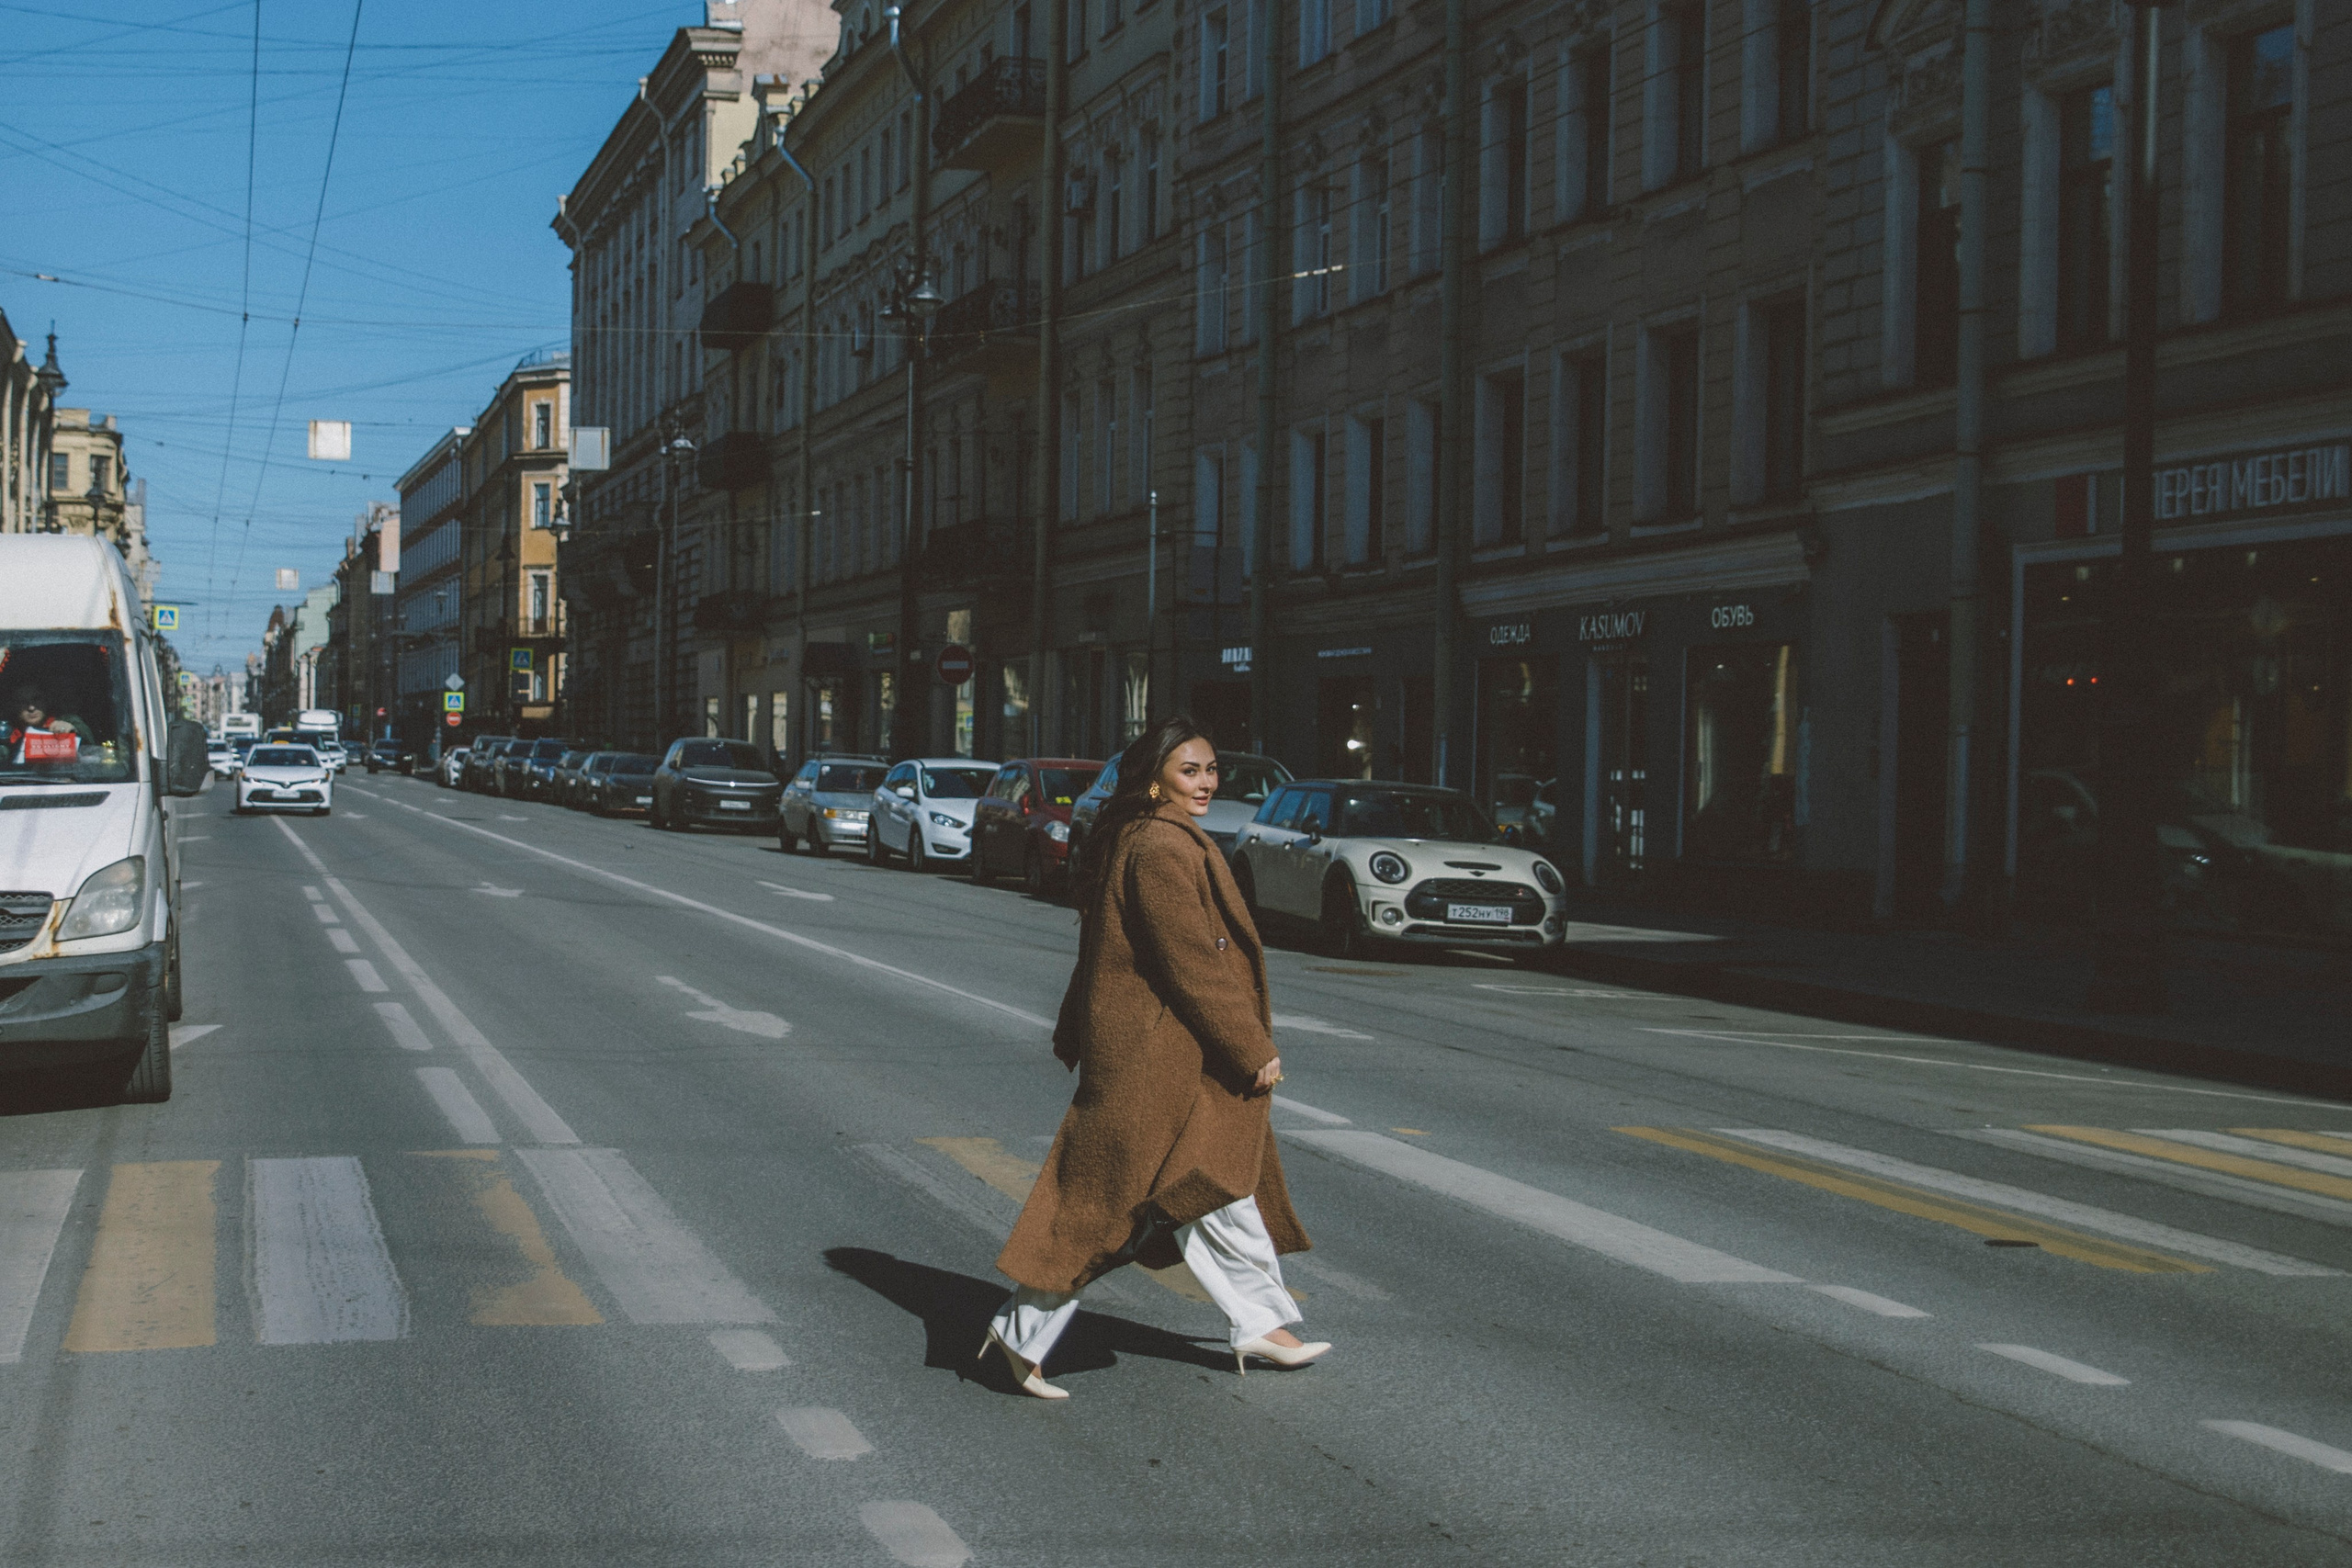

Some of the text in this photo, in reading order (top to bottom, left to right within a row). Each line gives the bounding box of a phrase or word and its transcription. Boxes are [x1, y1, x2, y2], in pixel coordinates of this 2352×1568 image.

[2153, 445, 2350, 520] ЕРЕЯ МЕБЕЛИ
[1579, 611, 1645, 641] KASUMOV
[1711, 604, 1755, 628] ОБУВЬ
[1489, 624, 1532, 645] ОДЕЖДА
[1452, 907, 1492, 919] Т252НУ
